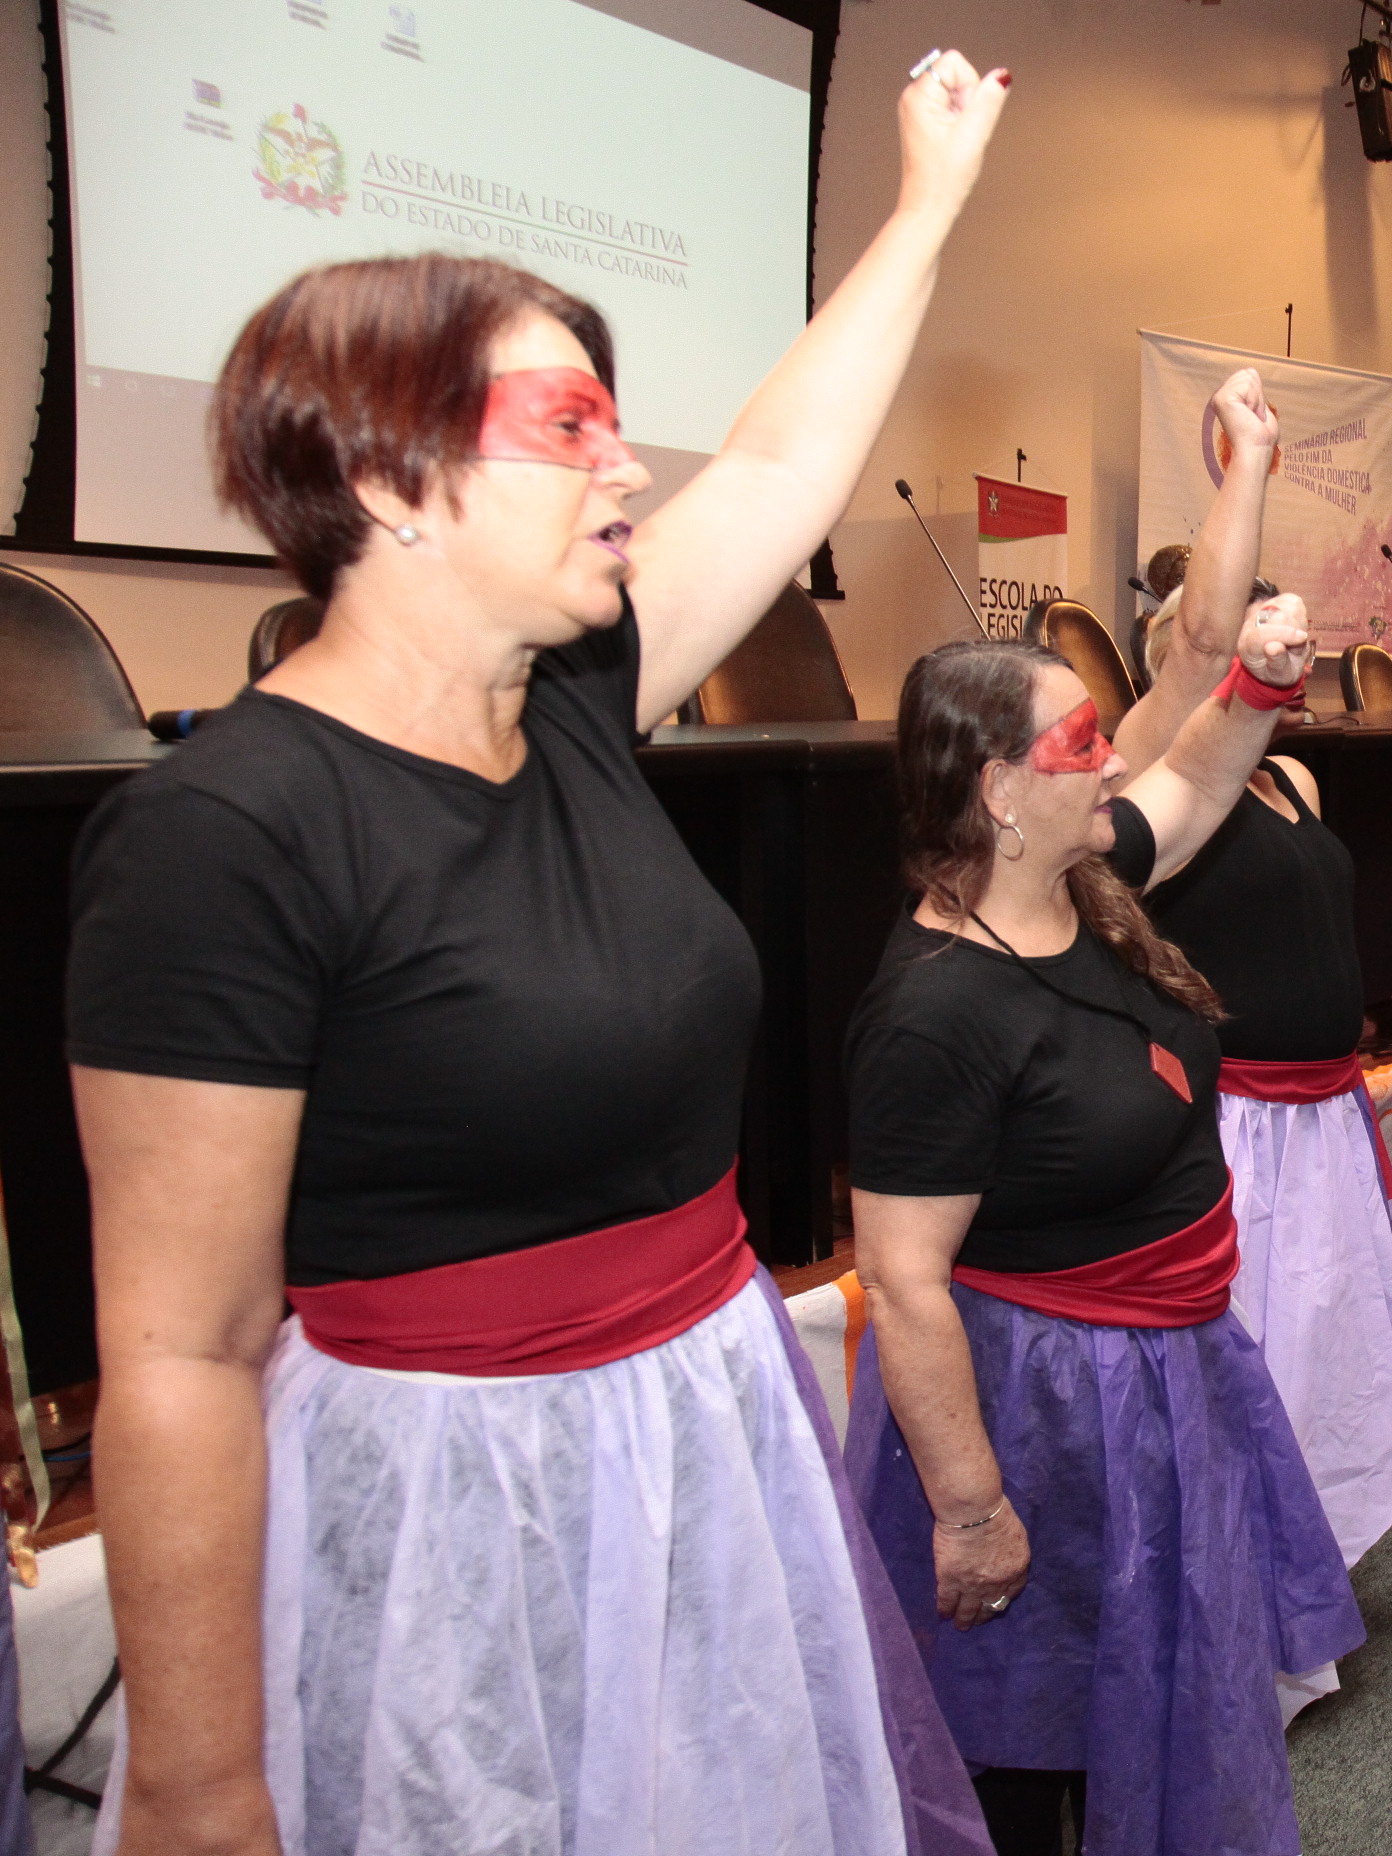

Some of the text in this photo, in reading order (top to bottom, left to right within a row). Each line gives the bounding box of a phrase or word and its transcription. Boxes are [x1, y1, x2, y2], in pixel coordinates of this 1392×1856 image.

[363, 149, 688, 258] ASSEMBLEIA LEGISLATIVA
[361, 189, 689, 291] DO ESTADO DE SANTA CATARINA
[1329, 417, 1367, 446] REGIONAL
[1284, 449, 1333, 465] PELO FIM DA
[1284, 462, 1325, 481] VIOLÊNCIA
[1284, 471, 1357, 516] CONTRA A MULHER
[979, 577, 1038, 612] ESCOLA
[980, 611, 1023, 639] LEGISL
